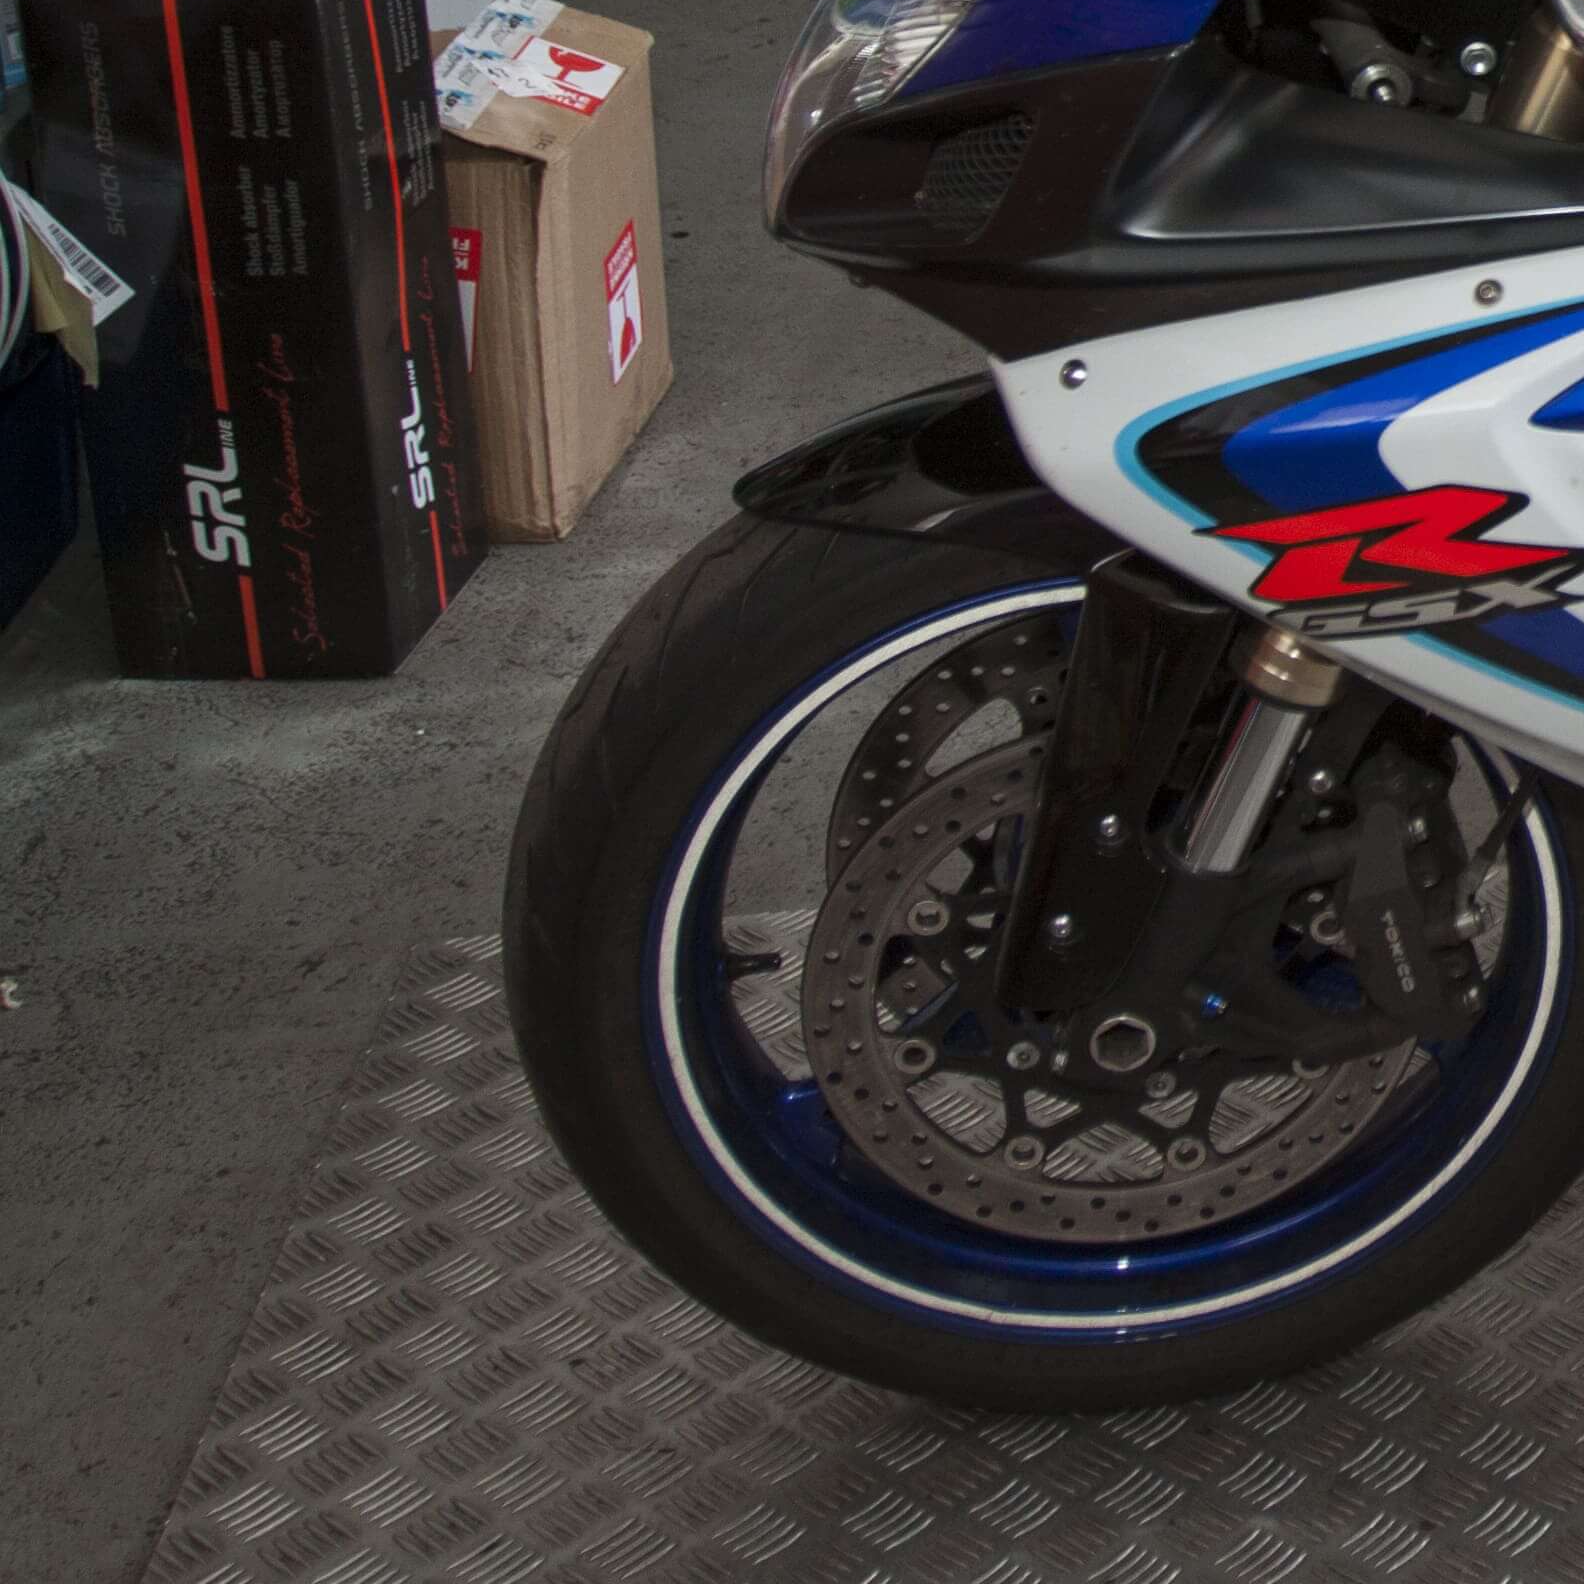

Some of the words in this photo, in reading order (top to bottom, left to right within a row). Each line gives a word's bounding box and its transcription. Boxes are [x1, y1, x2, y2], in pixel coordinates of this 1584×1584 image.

[102, 164, 128, 238] SHOCK
[236, 165, 258, 229] absorber
[283, 178, 309, 276] Amortiguador
[243, 232, 266, 277] Shock
[264, 333, 297, 382] Line
[265, 386, 319, 538] Replacement
